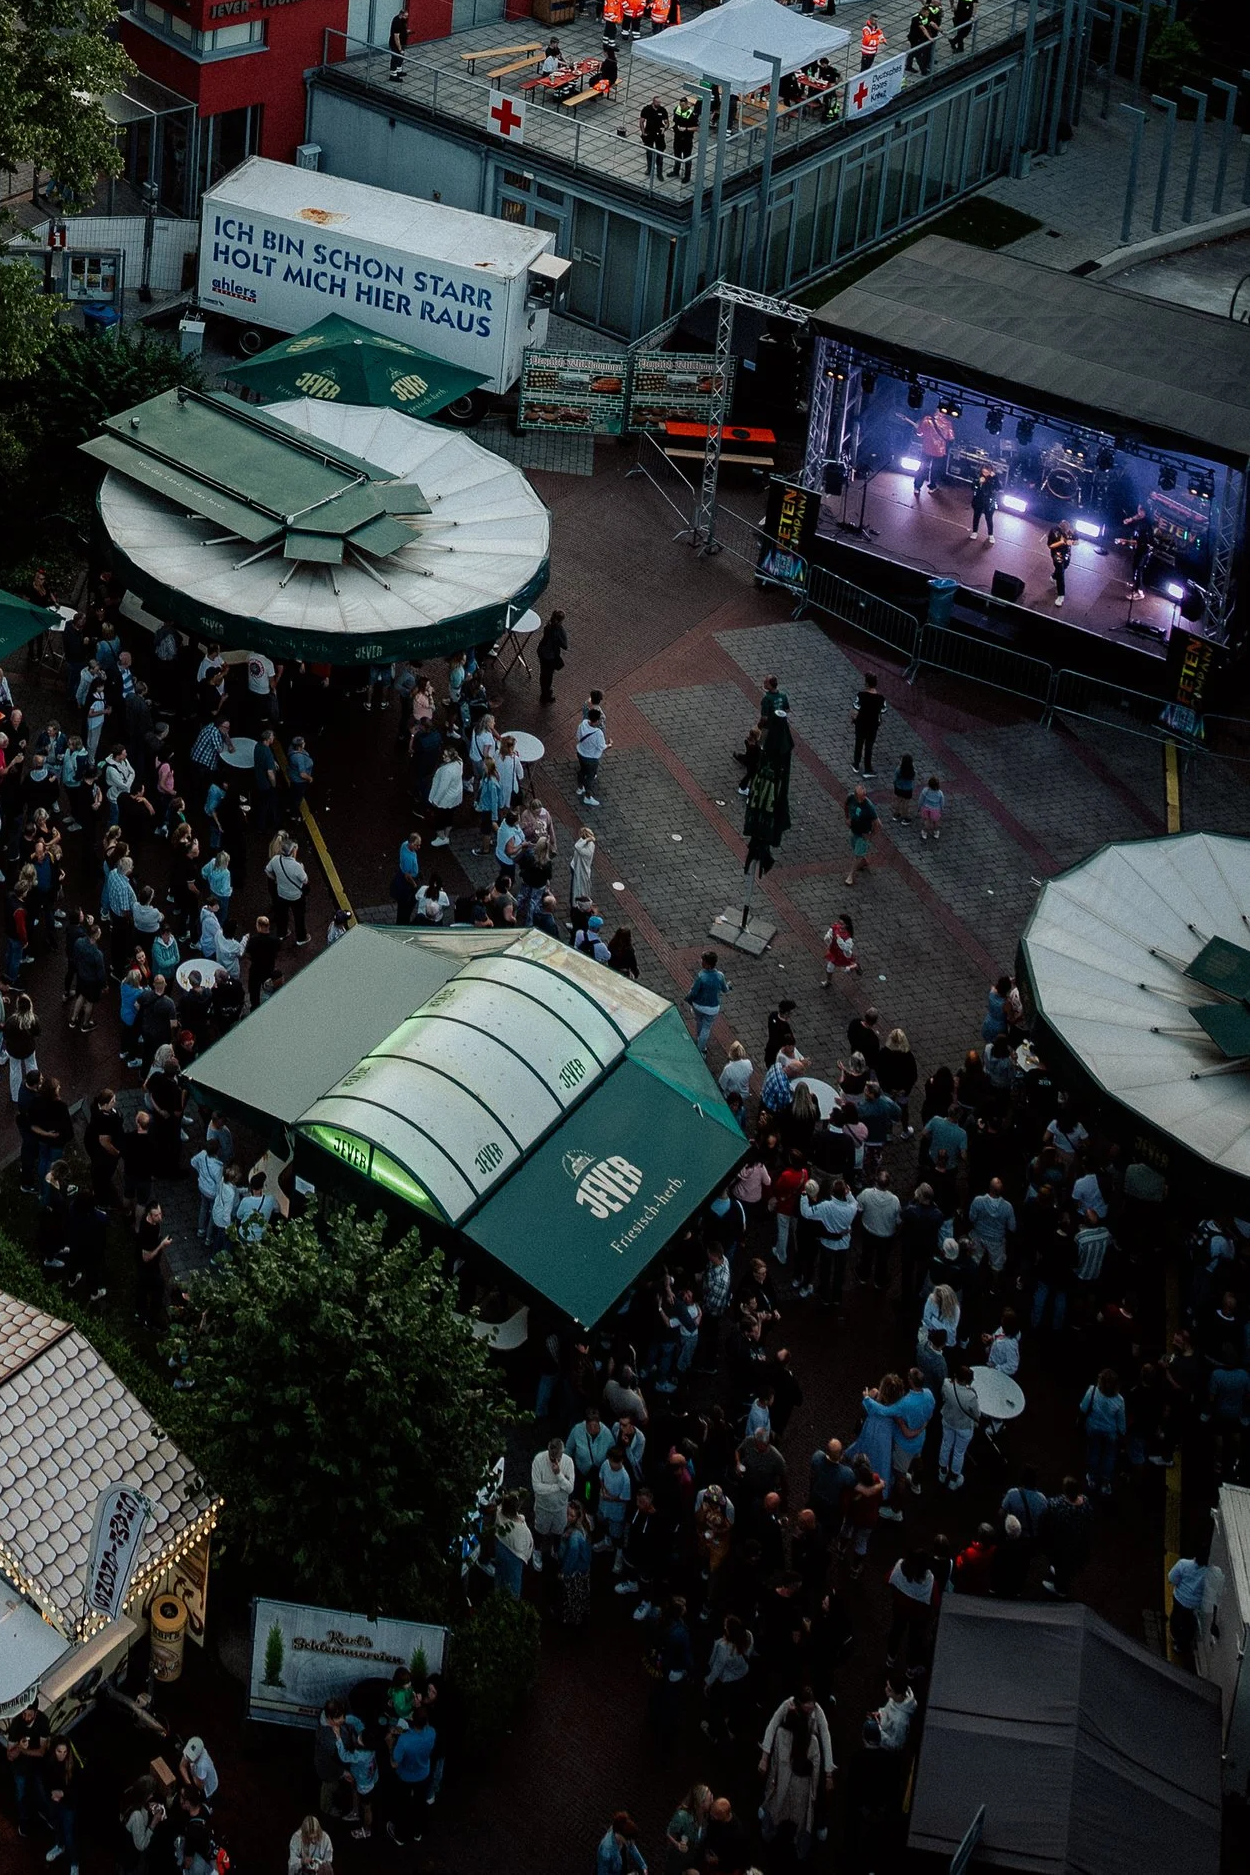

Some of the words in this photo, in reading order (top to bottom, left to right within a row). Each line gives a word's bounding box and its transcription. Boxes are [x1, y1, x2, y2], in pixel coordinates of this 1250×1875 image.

[210, 0, 249, 19] JEVER
[872, 64, 902, 83] Deutsches
[214, 216, 254, 245] ICH
[262, 229, 304, 259] BIN
[313, 244, 403, 286] SCHON
[413, 271, 492, 311] STARR
[212, 277, 257, 298] ahlers
[213, 242, 277, 277] HOLT
[282, 263, 346, 298] MICH
[355, 281, 412, 316] HIER
[420, 300, 491, 337] RAUS
[295, 372, 341, 400] JEVER
[390, 374, 429, 401] JEVER
[775, 486, 798, 552] FETEN
[355, 645, 383, 659] JEVER
[1177, 637, 1203, 705] FETEN
[559, 1058, 587, 1089] JEVER
[333, 1138, 367, 1169] JEVER
[474, 1142, 504, 1175] JEVER
[576, 1155, 643, 1219] JEVER
[610, 1177, 686, 1254] Friesisch-herb.
